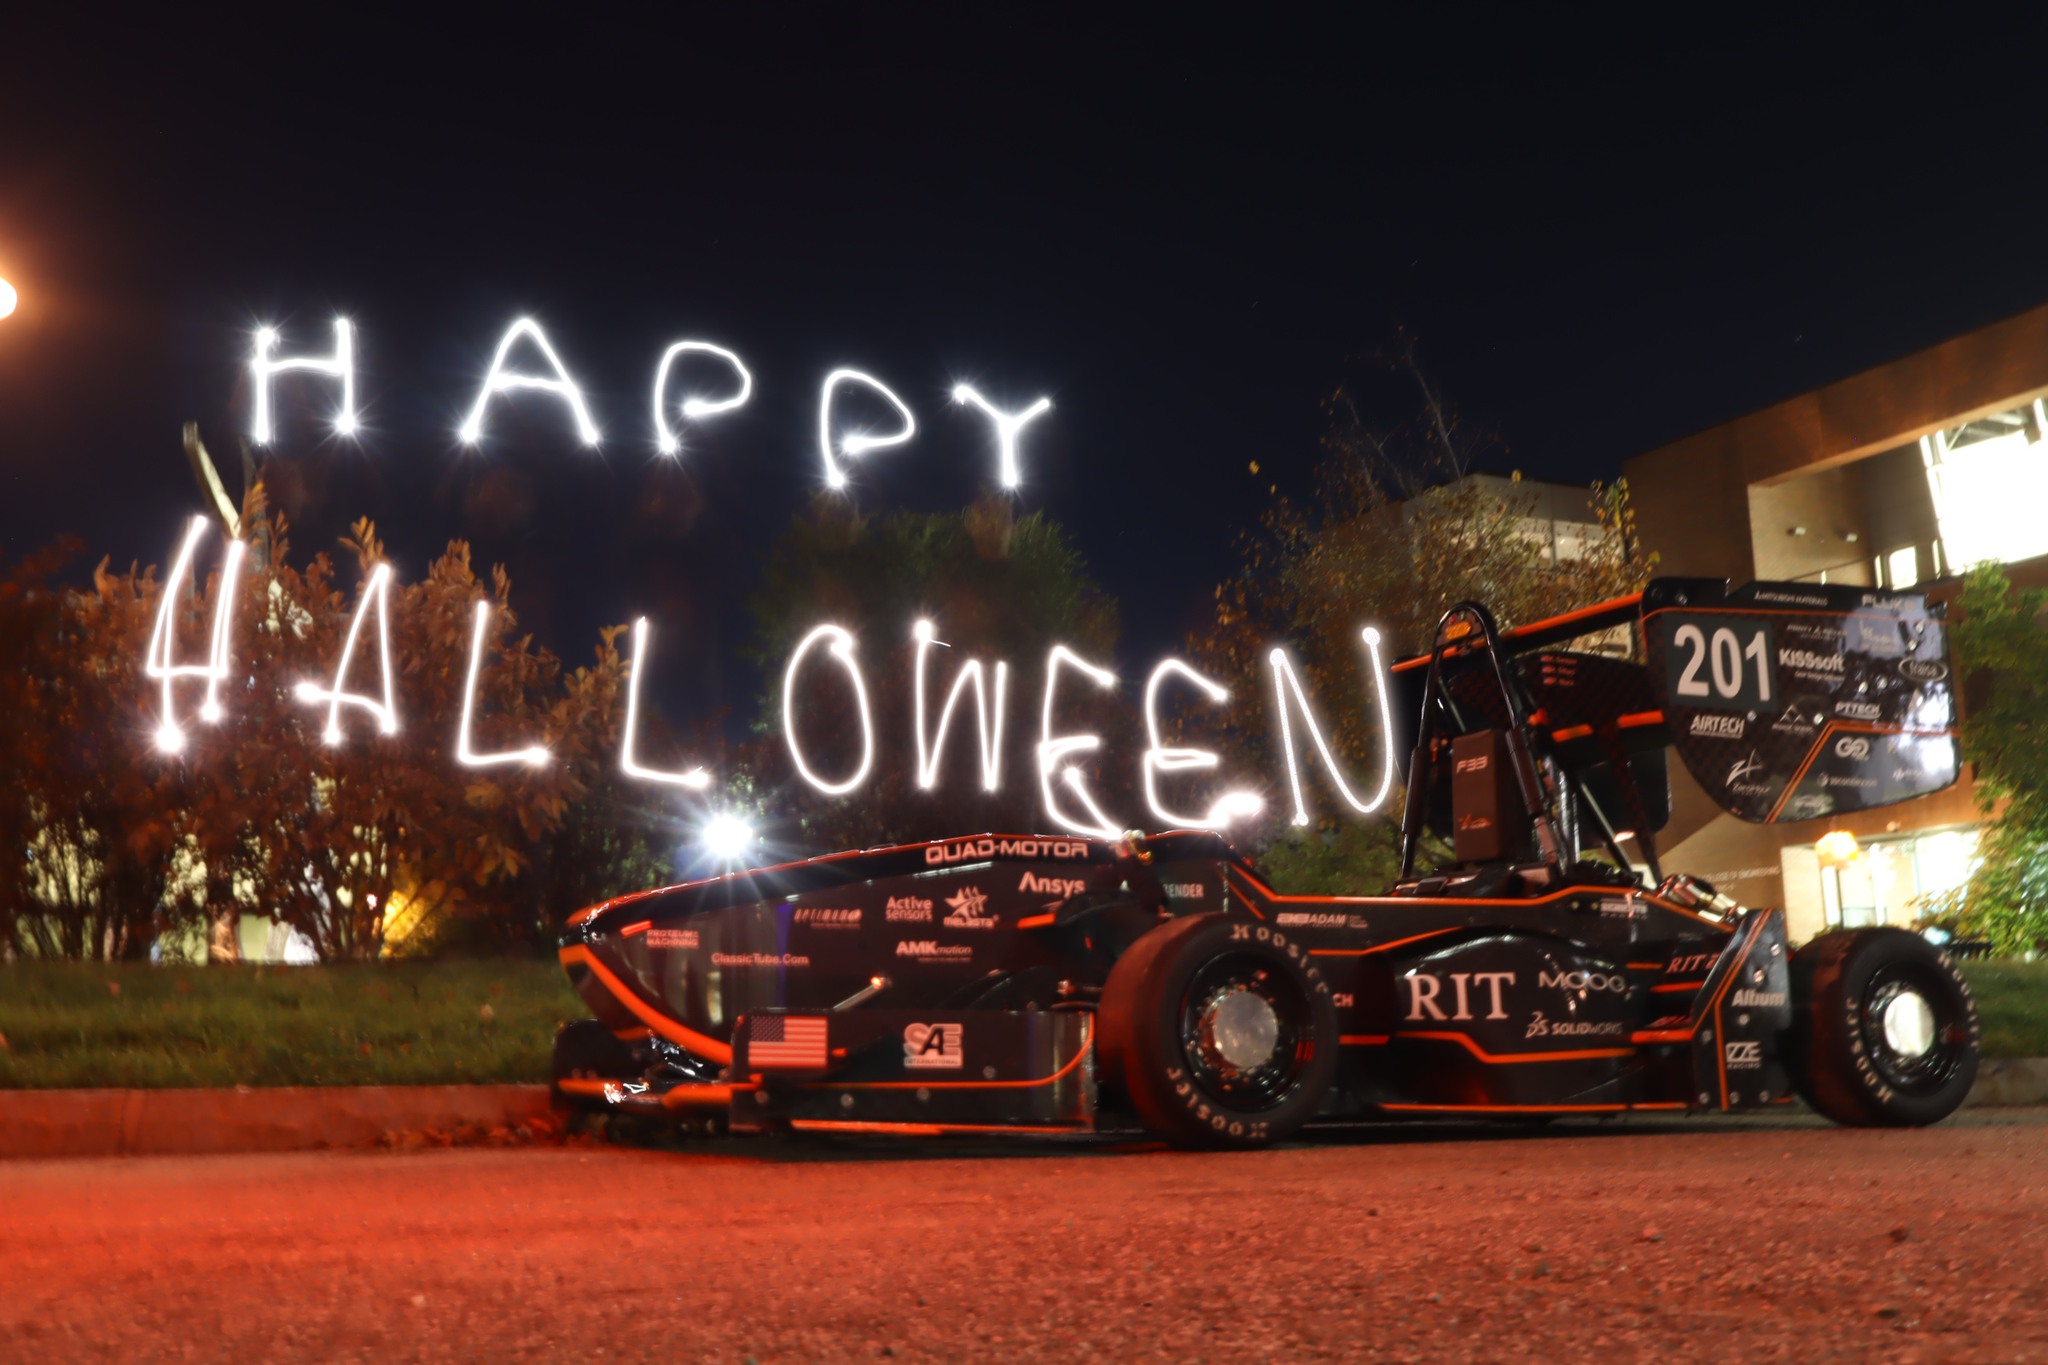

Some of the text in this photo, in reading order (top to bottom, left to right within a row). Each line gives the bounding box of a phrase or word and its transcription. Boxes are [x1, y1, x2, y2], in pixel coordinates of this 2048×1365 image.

[248, 314, 1053, 490] HAPPY
[1673, 622, 1771, 702] 201
[143, 512, 1398, 840] HALLOWEEN
[1690, 714, 1745, 735] AIRTECH
[1456, 755, 1489, 774] F33
[925, 839, 1089, 865] QUAD-MOTOR
[1018, 870, 1086, 899] Ansys
[885, 907, 934, 922] sensors
[886, 896, 934, 911] Active
[1309, 913, 1347, 925] ADAM
[710, 951, 812, 966] ClassicTube.Com
[1665, 953, 1705, 975] RIT
[1538, 970, 1626, 993] MOOG
[1402, 970, 1516, 1021] RIT
[1731, 987, 1787, 1007] Altium
[903, 1022, 964, 1056] SAE
[1551, 1021, 1624, 1036] SOLIDWORKS
